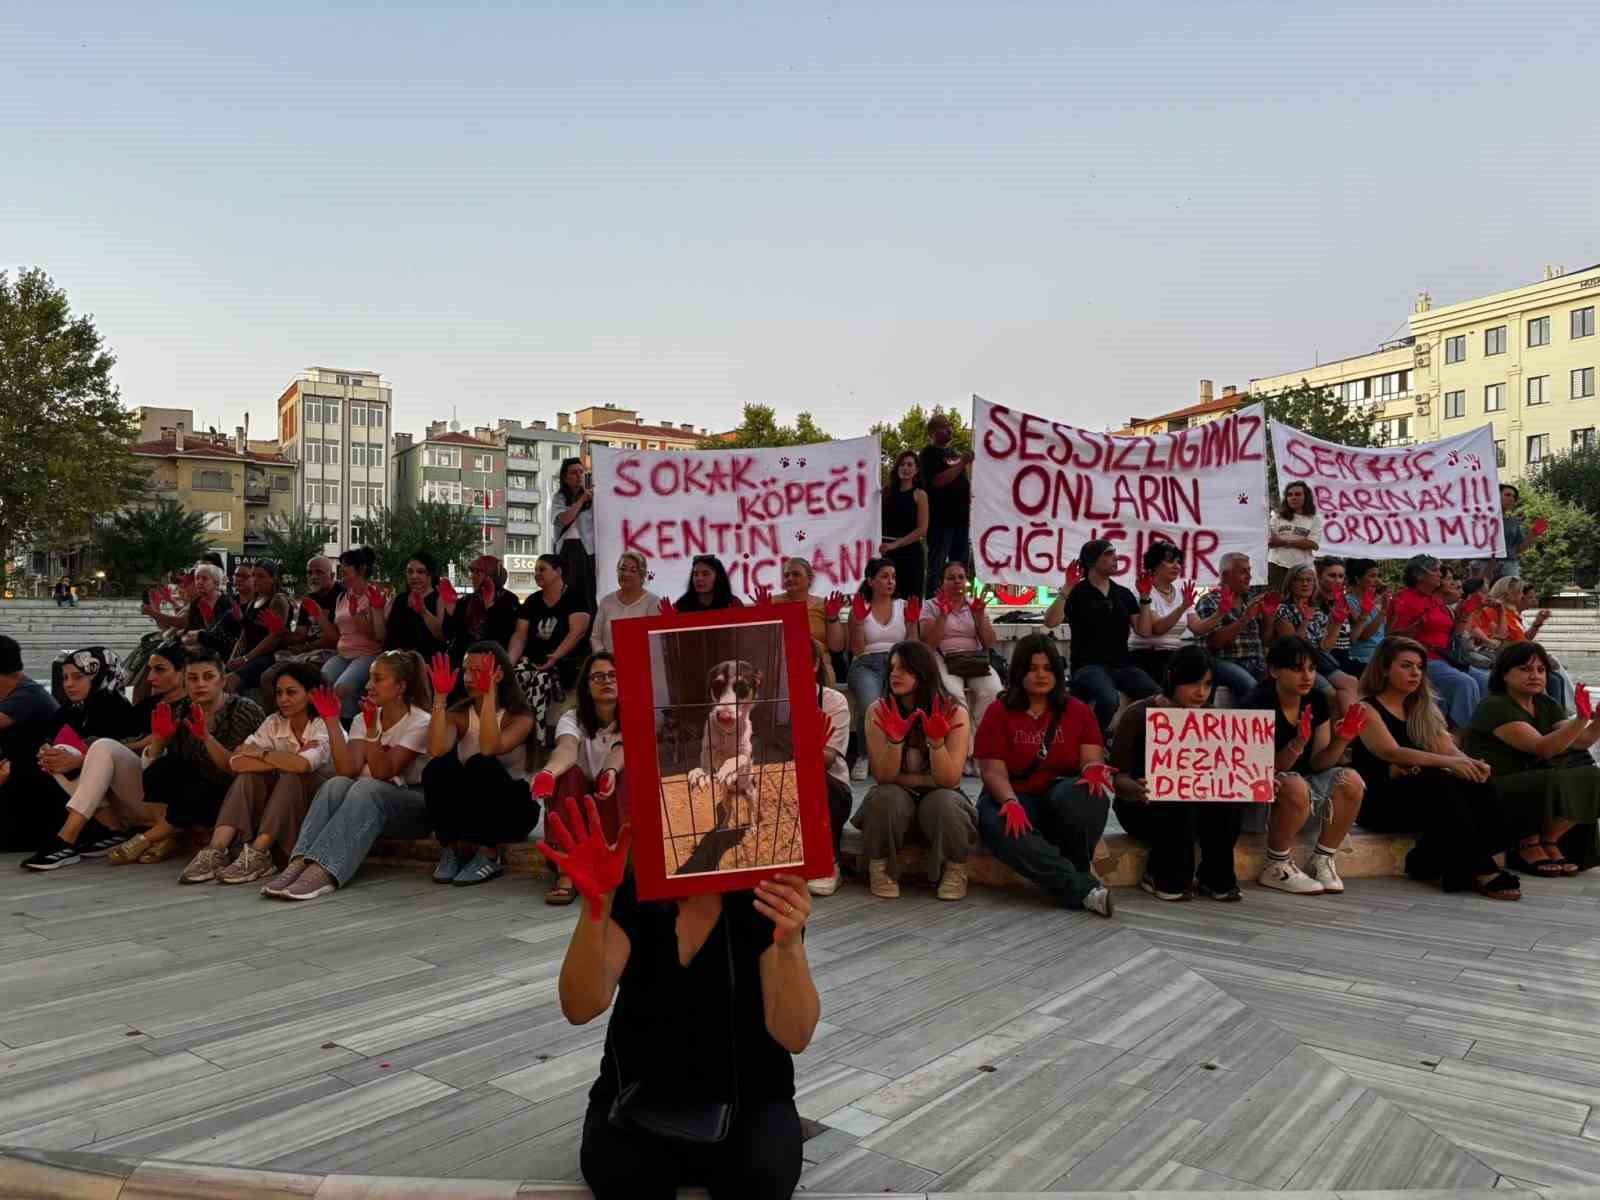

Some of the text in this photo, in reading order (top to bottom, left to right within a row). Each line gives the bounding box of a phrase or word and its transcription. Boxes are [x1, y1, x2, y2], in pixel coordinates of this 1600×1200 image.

[613, 456, 757, 497] SOKAK
[1282, 438, 1437, 481] SEN HİÇ
[738, 461, 869, 523] KÖPEĞİ
[1012, 465, 1201, 524] ONLARIN
[622, 516, 780, 560] KENTİN
[1323, 512, 1500, 559] ÖRDÜN MÜ?
[1148, 711, 1275, 745] BARINAK
[1151, 745, 1248, 775] MEZAR
